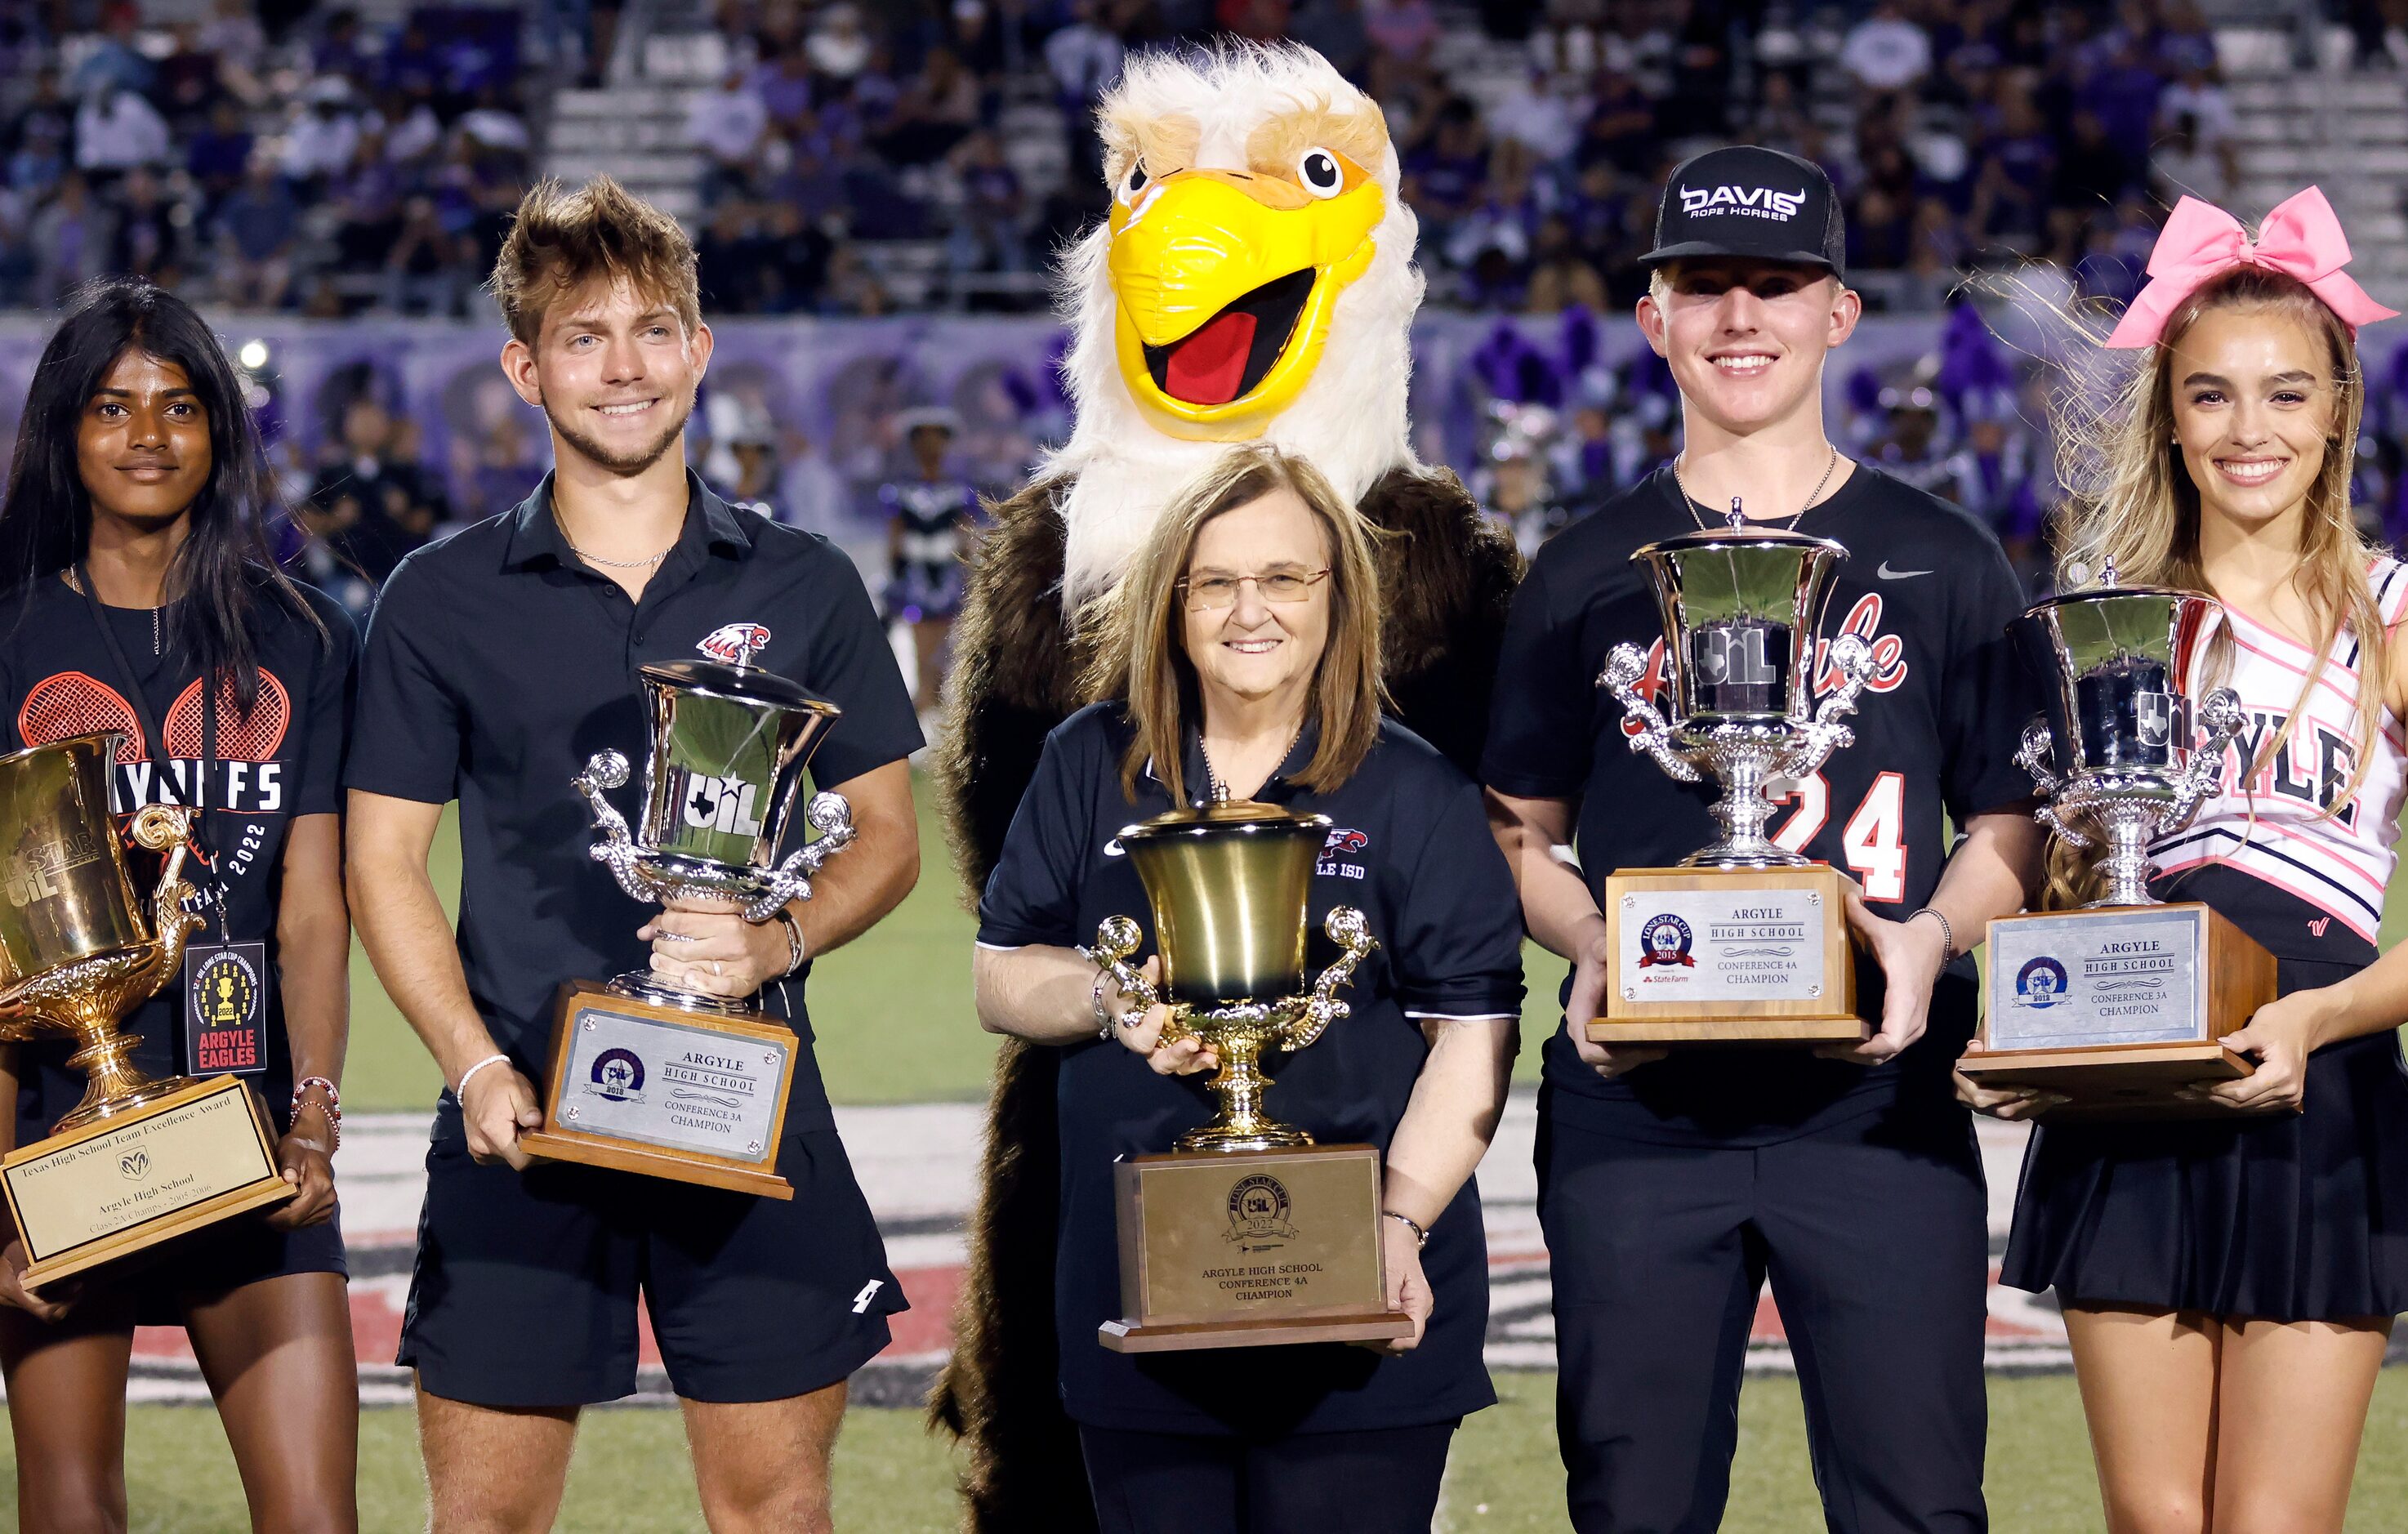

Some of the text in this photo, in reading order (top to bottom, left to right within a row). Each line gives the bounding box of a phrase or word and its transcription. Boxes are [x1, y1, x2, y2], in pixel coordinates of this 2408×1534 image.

[1679, 183, 1806, 216] DAVIS
[1690, 207, 1788, 222] ROPE HORSES
[1761, 770, 1907, 903] 24
[25, 833, 98, 872] STAR
[229, 824, 265, 876] 2022
[1340, 863, 1365, 880] ISD
[1732, 907, 1783, 919] ARGYLE
[1643, 915, 1691, 940] LONE STAR CUP
[1711, 927, 1804, 938] HIGH SCHOOL
[2100, 940, 2161, 954] ARGYLE
[1656, 951, 1677, 960] 2015
[196, 969, 206, 979] UIL
[203, 956, 216, 971] LONE
[214, 952, 227, 962] STAR
[228, 952, 238, 961] CUP
[237, 955, 258, 987] CHAMPIONS
[1718, 961, 1798, 970] CONFERENCE 4A
[2085, 958, 2174, 973] HIGH SCHOOL
[1727, 974, 1789, 984] CHAMPION
[2091, 991, 2168, 1004] CONFERENCE 3A
[218, 1007, 233, 1016] 2022
[2099, 1004, 2159, 1017] CHAMPION
[198, 1029, 255, 1050] ARGYLE
[198, 1047, 256, 1068] EAGLES
[683, 1051, 745, 1072] ARGYLE
[664, 1068, 756, 1092] HIGH SCHOOL
[664, 1101, 742, 1122] CONFERENCE 3A
[671, 1114, 732, 1134] CHAMPION
[20, 1162, 49, 1178] Texas
[51, 1153, 77, 1168] High
[78, 1139, 111, 1158] School
[113, 1130, 140, 1145] Team
[144, 1110, 195, 1135] Excellence
[198, 1097, 231, 1117] Award
[1247, 1177, 1273, 1190] STAR
[99, 1174, 194, 1215] Argyle High School
[89, 1221, 113, 1234] Class
[114, 1215, 127, 1226] 2A
[128, 1203, 163, 1221] Champs
[1247, 1219, 1273, 1230] 2022
[1202, 1263, 1323, 1278] ARGYLE HIGH SCHOOL
[1219, 1276, 1308, 1289] CONFERENCE 4A
[1235, 1289, 1293, 1300] CHAMPION
